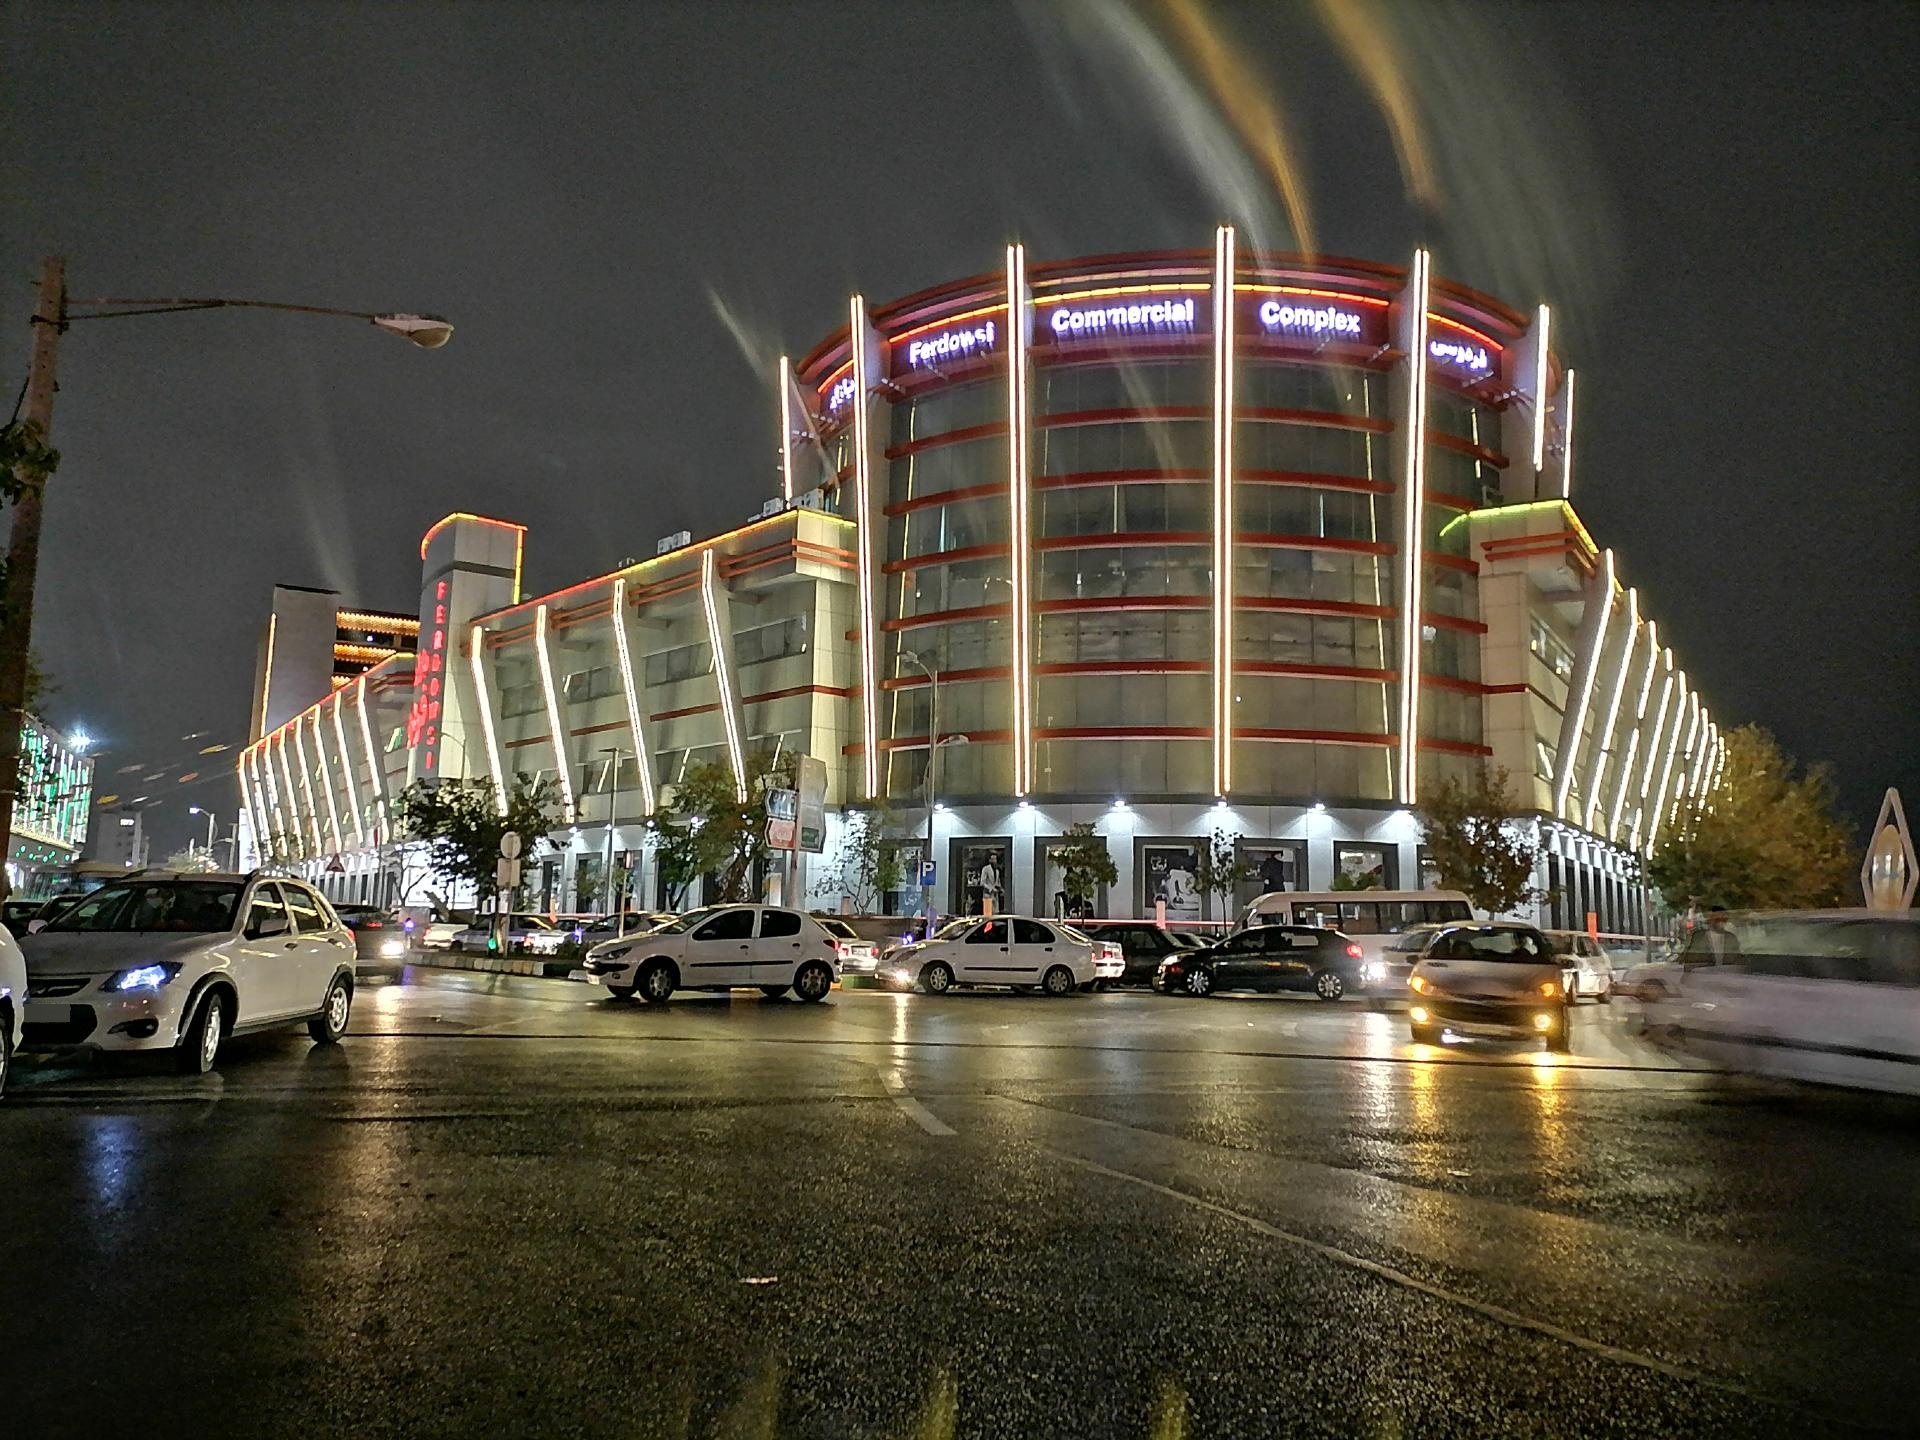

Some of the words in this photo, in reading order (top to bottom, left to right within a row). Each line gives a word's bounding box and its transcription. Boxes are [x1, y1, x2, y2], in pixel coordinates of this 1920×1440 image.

[909, 321, 995, 364] Ferdowsi
[1051, 298, 1194, 332] Commercial
[1260, 301, 1361, 333] Complex
[922, 861, 935, 877] P
